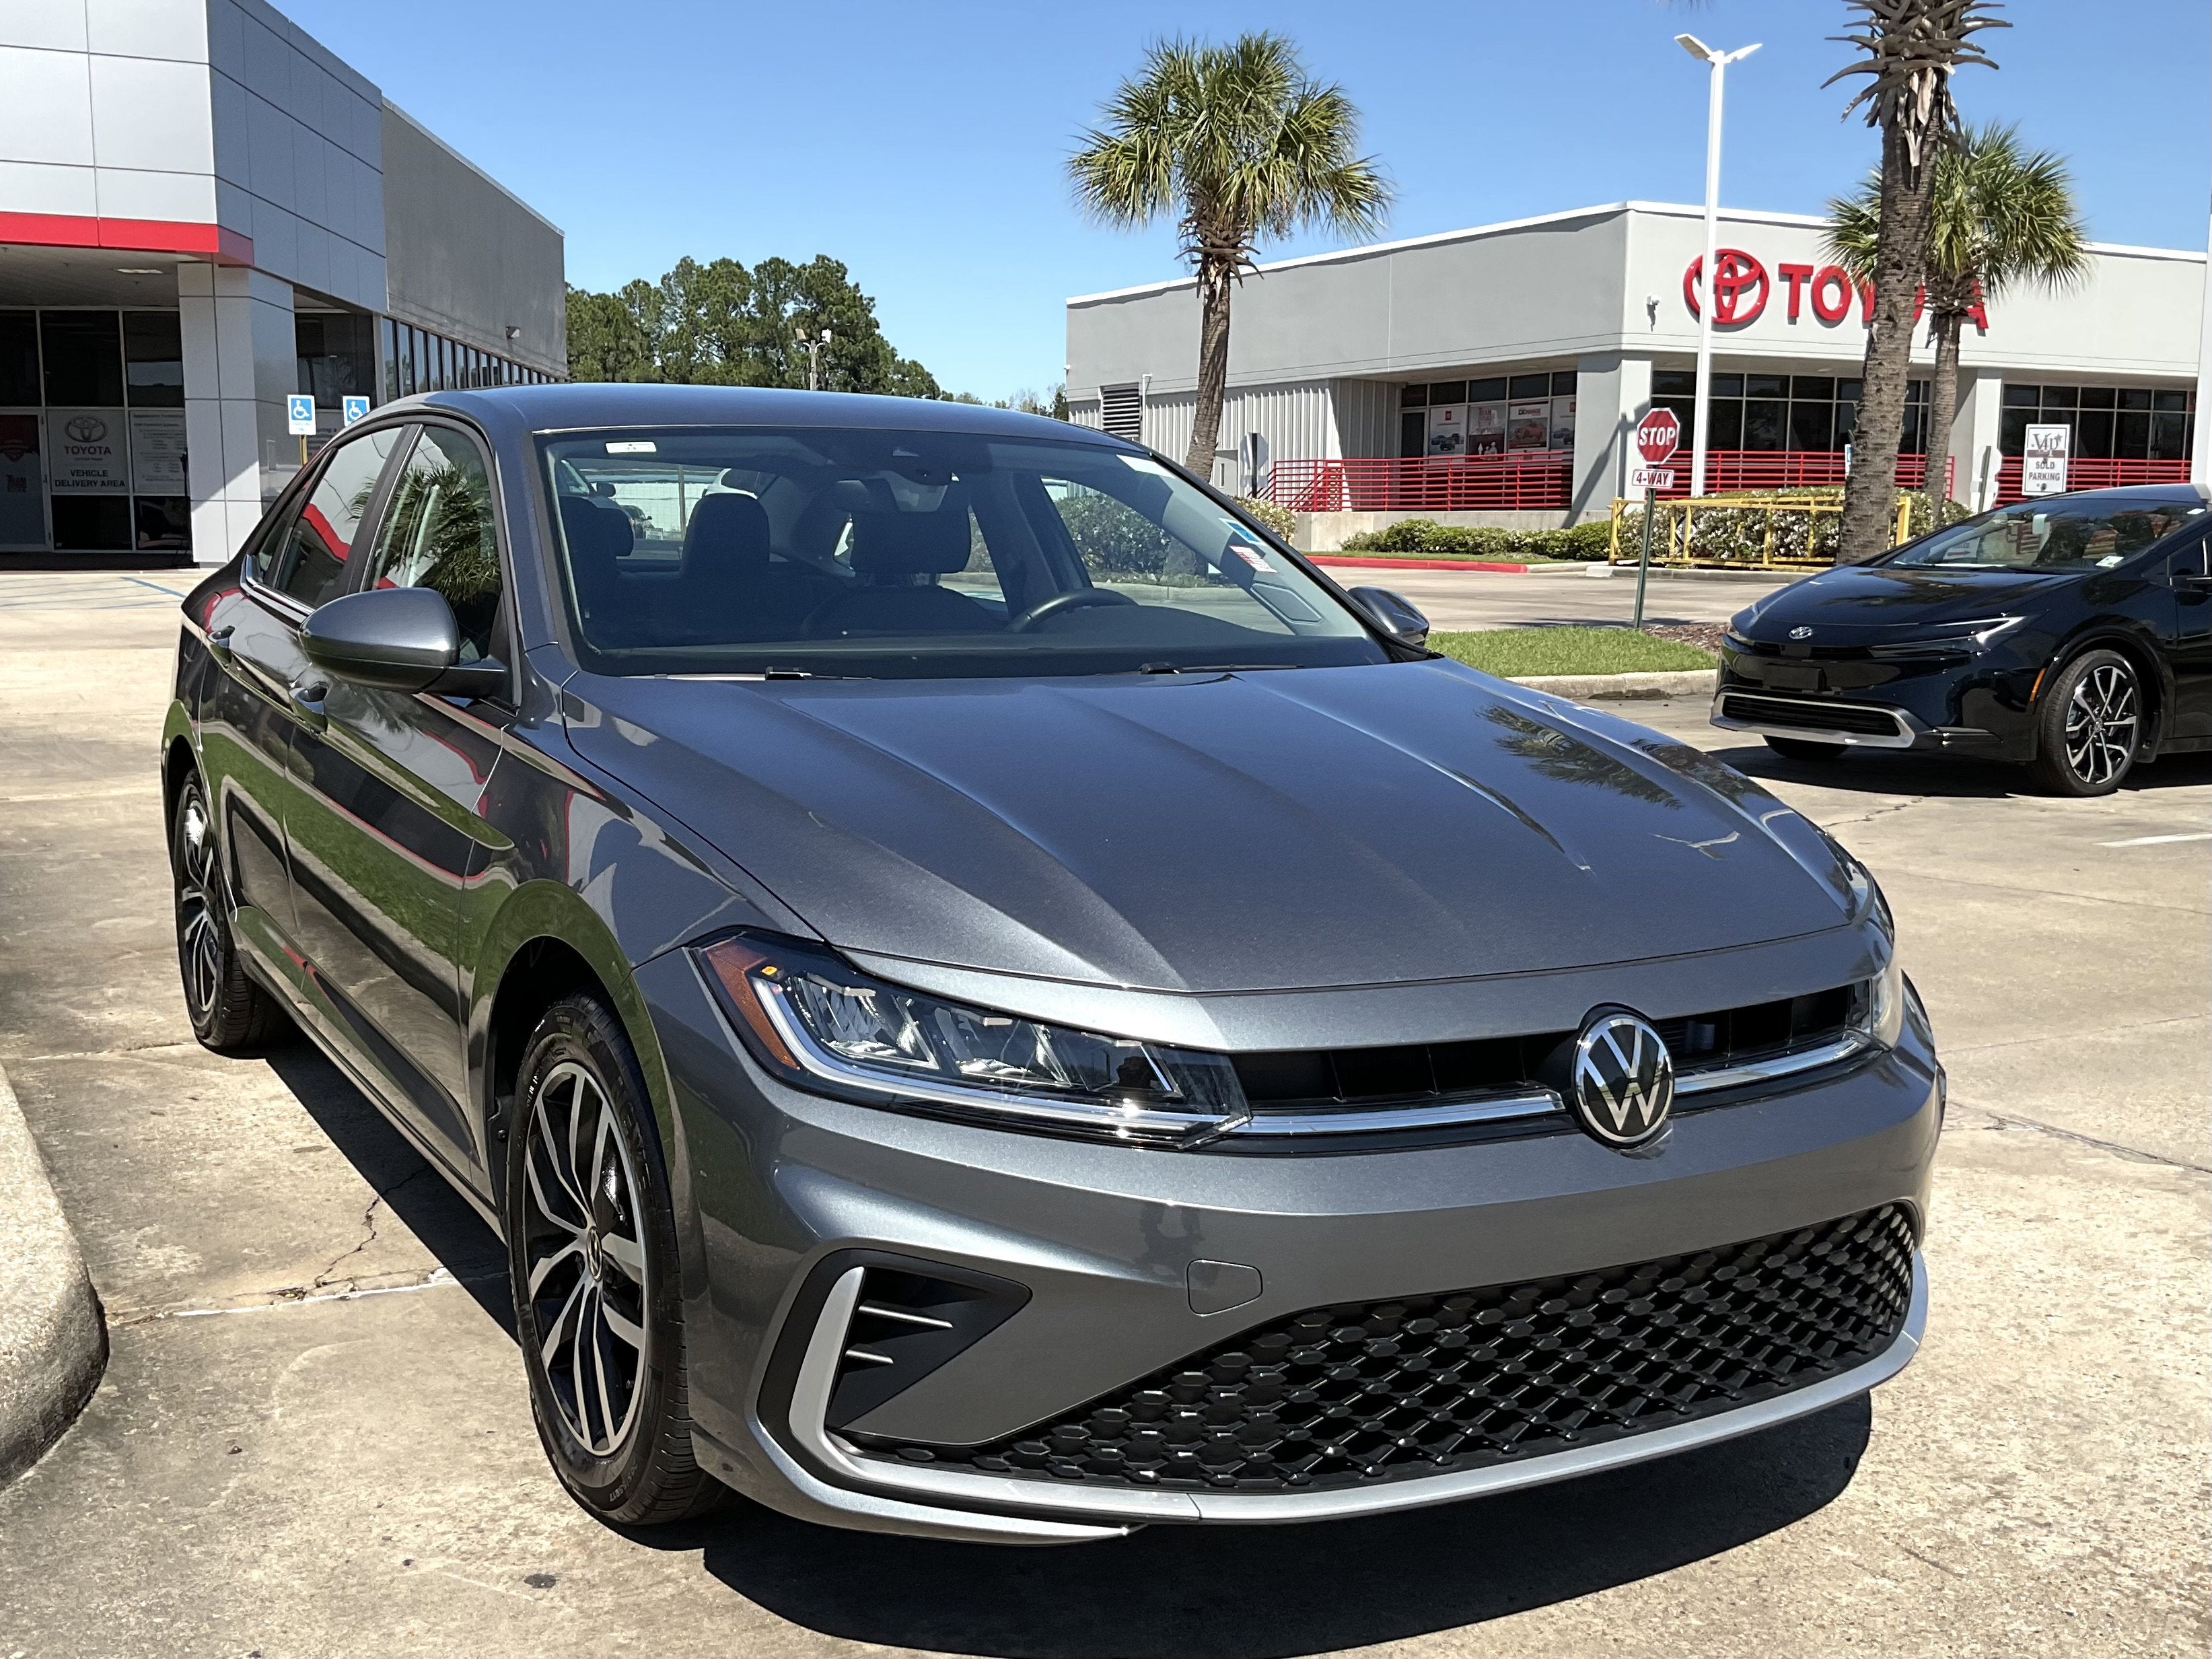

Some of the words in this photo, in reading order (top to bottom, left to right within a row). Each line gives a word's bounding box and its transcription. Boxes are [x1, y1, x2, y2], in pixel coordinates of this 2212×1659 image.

[1639, 427, 1676, 446] STOP
[65, 446, 112, 456] TOYOTA
[2035, 460, 2055, 470] SOLD
[1636, 472, 1669, 485] 4-WAY
[2028, 472, 2061, 481] PARKING
[55, 479, 98, 487] DELIVERY
[101, 479, 126, 487] AREA
